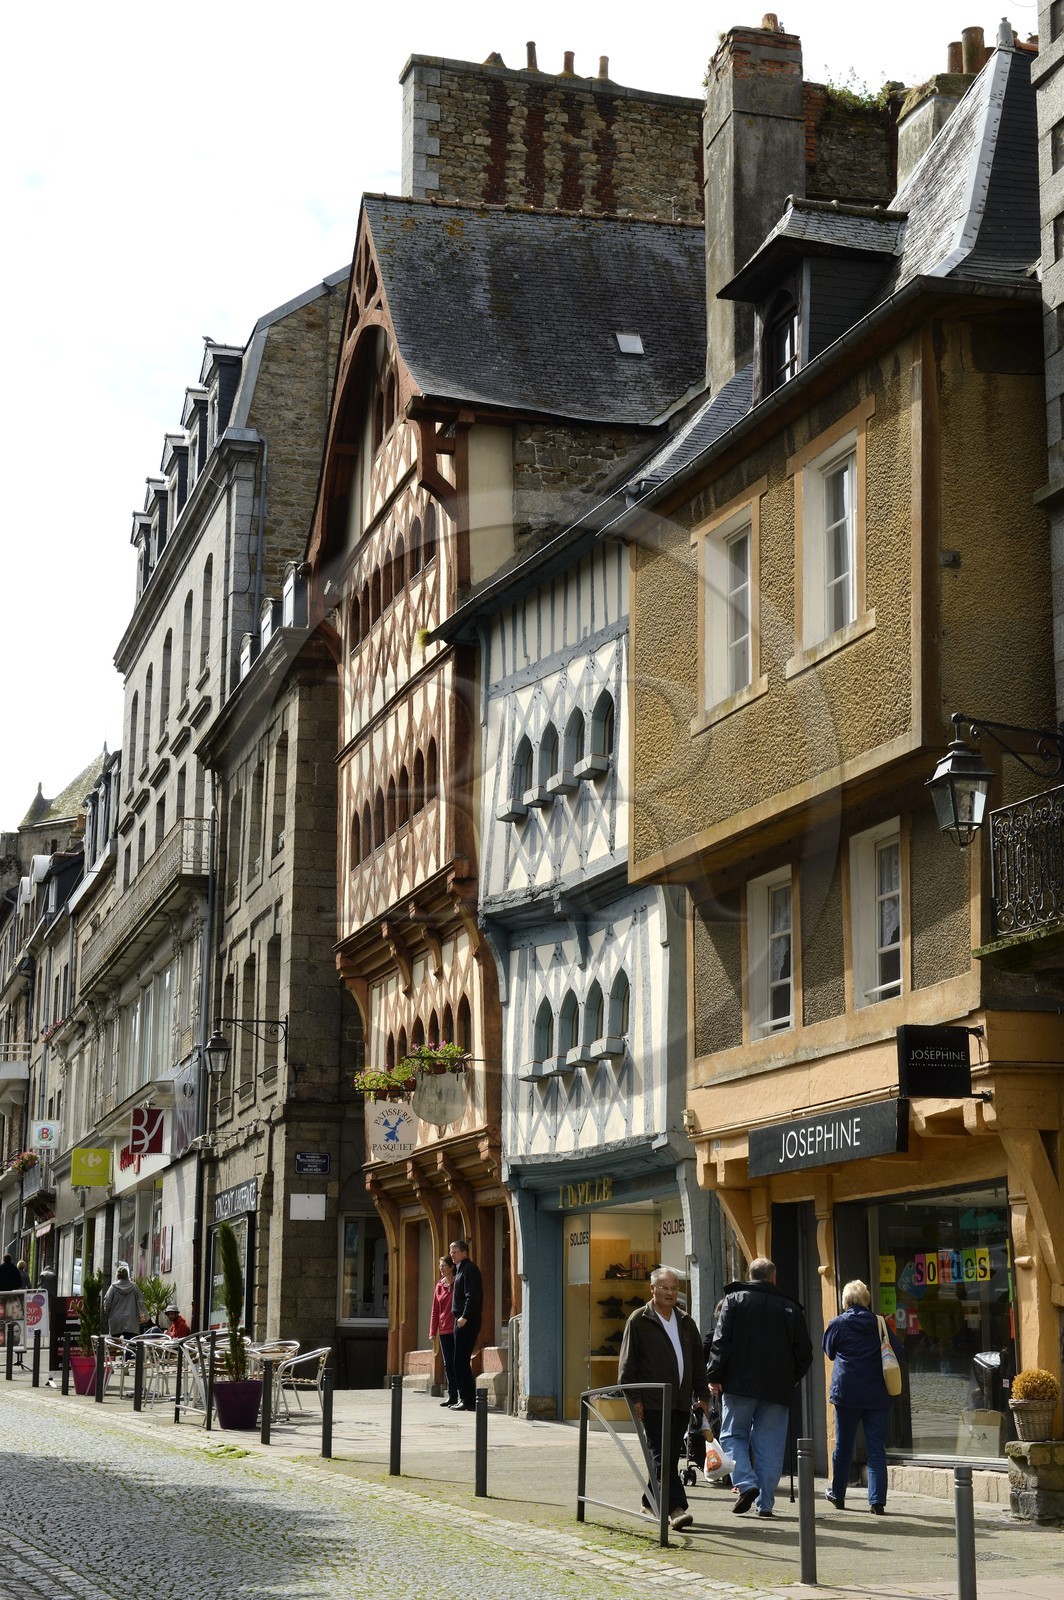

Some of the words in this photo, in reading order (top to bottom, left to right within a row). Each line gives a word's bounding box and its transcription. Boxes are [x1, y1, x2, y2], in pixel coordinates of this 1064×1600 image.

[910, 1049, 966, 1061] JOSEPHINE
[373, 1108, 414, 1126] PATISSERIE
[372, 1143, 414, 1152] PASQUIET
[778, 1117, 861, 1164] JOSEPHINE
[558, 1176, 613, 1208] IDYLLE
[569, 1231, 589, 1247] SOLDES
[915, 1249, 988, 1283] soldes
